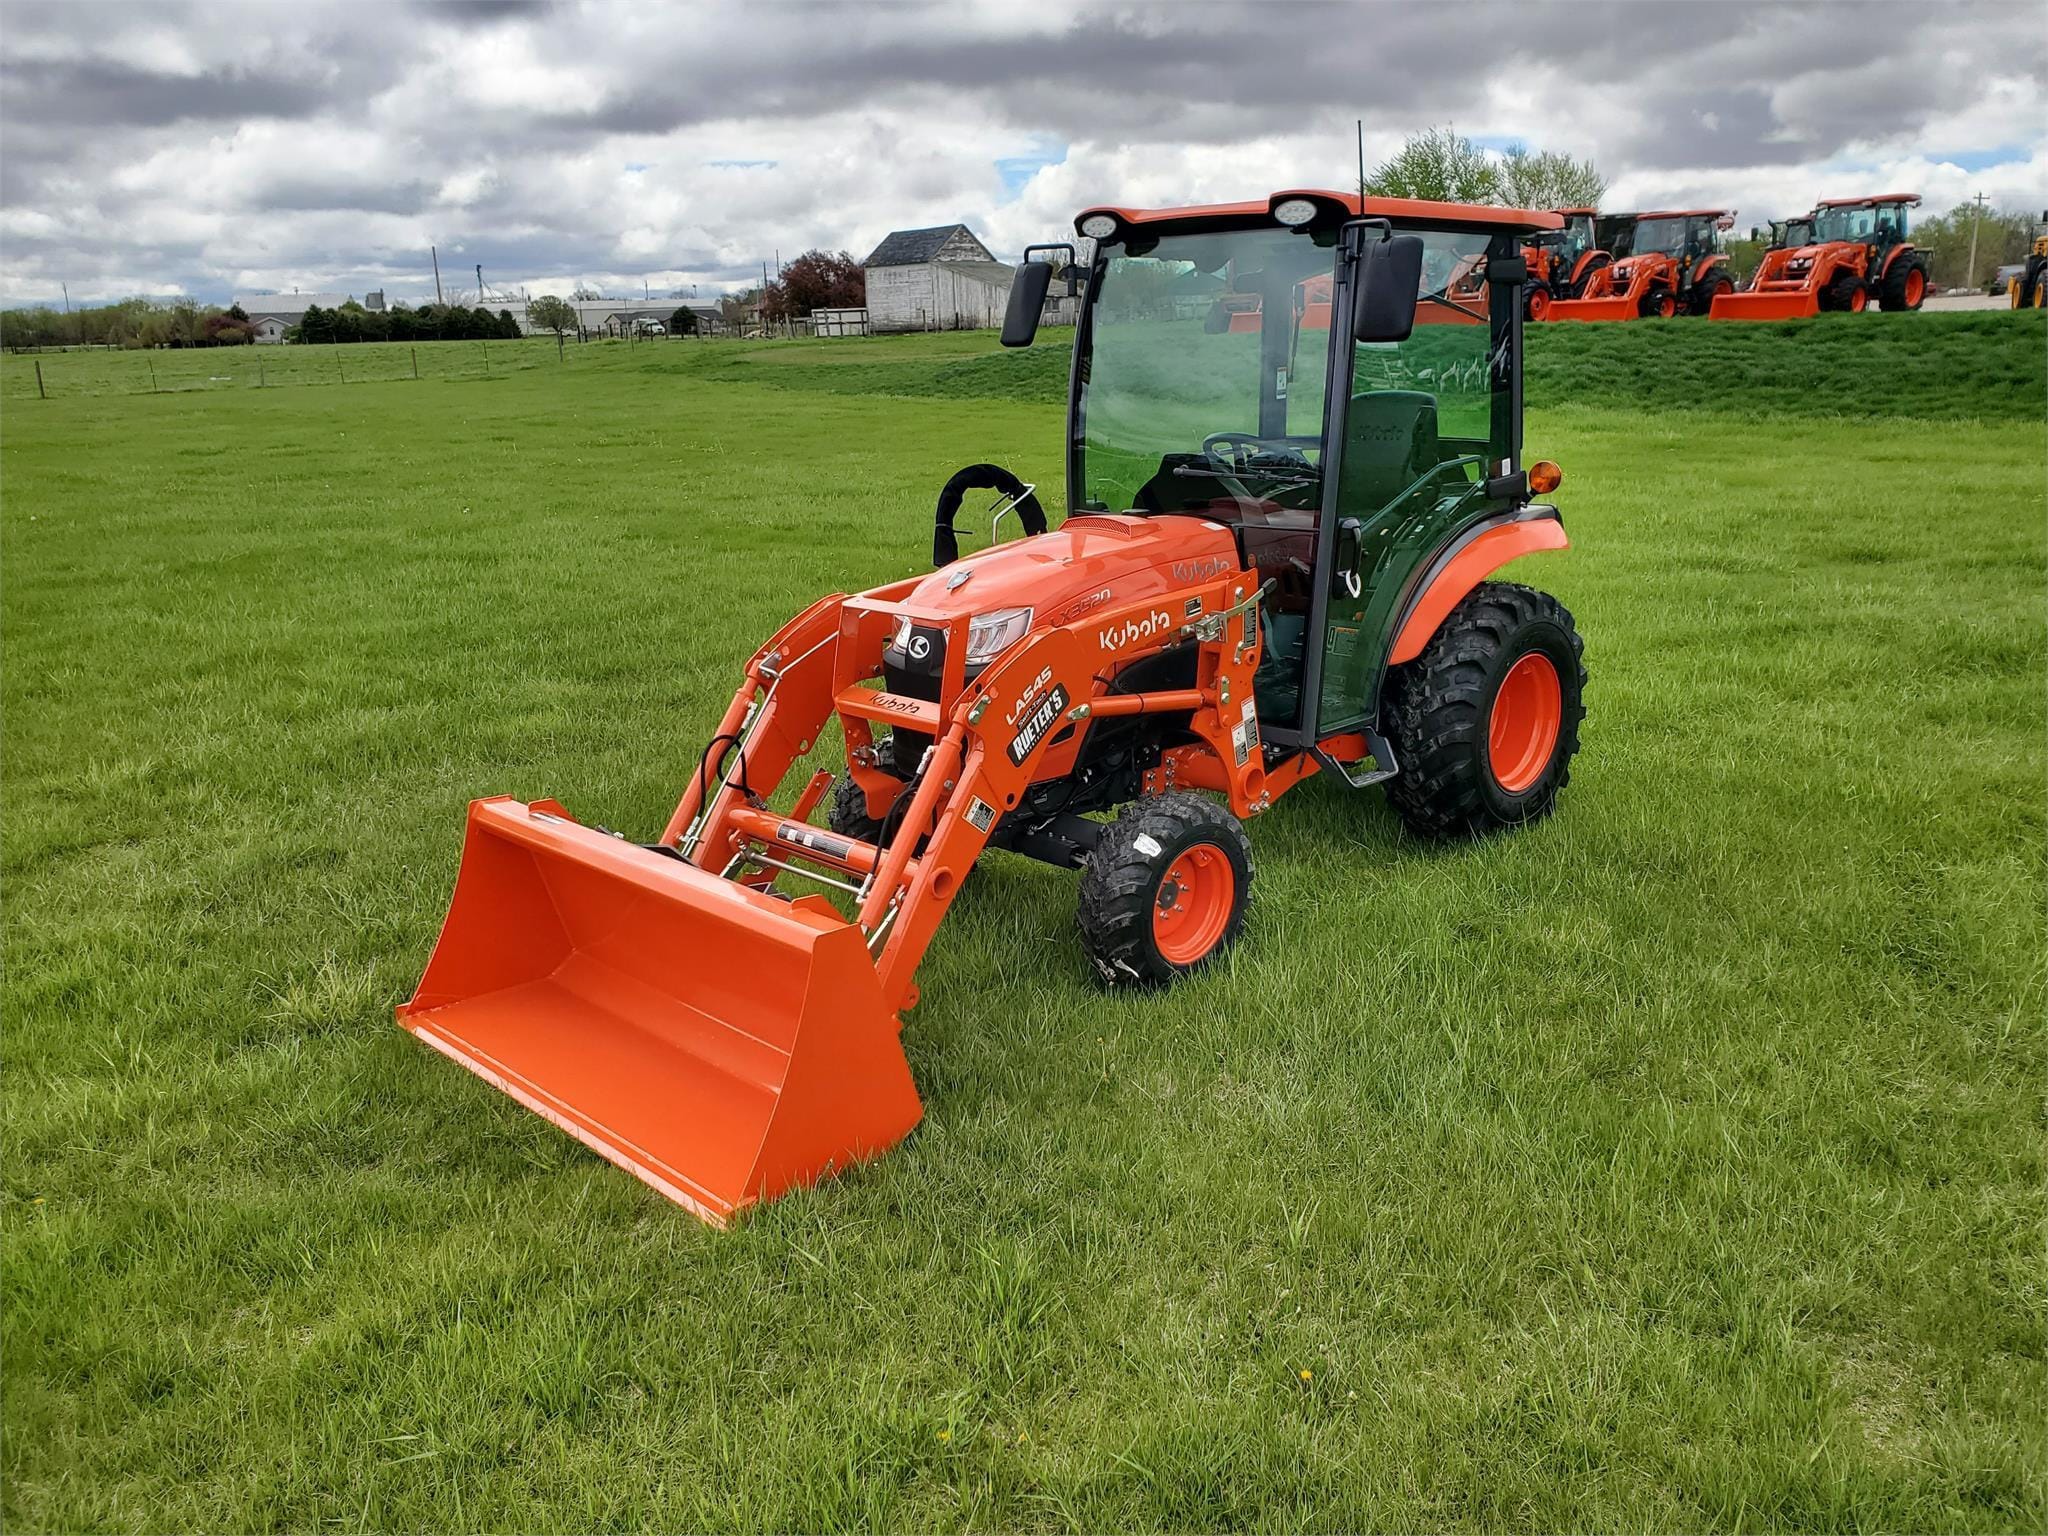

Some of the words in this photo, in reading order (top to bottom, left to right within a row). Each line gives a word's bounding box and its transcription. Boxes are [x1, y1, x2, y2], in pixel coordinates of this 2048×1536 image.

[1172, 557, 1230, 582] Kubota
[1099, 610, 1170, 651] Kubota
[869, 694, 920, 713] Kubota
[1005, 665, 1052, 725] LA545
[1013, 689, 1063, 760] RUETER'S
